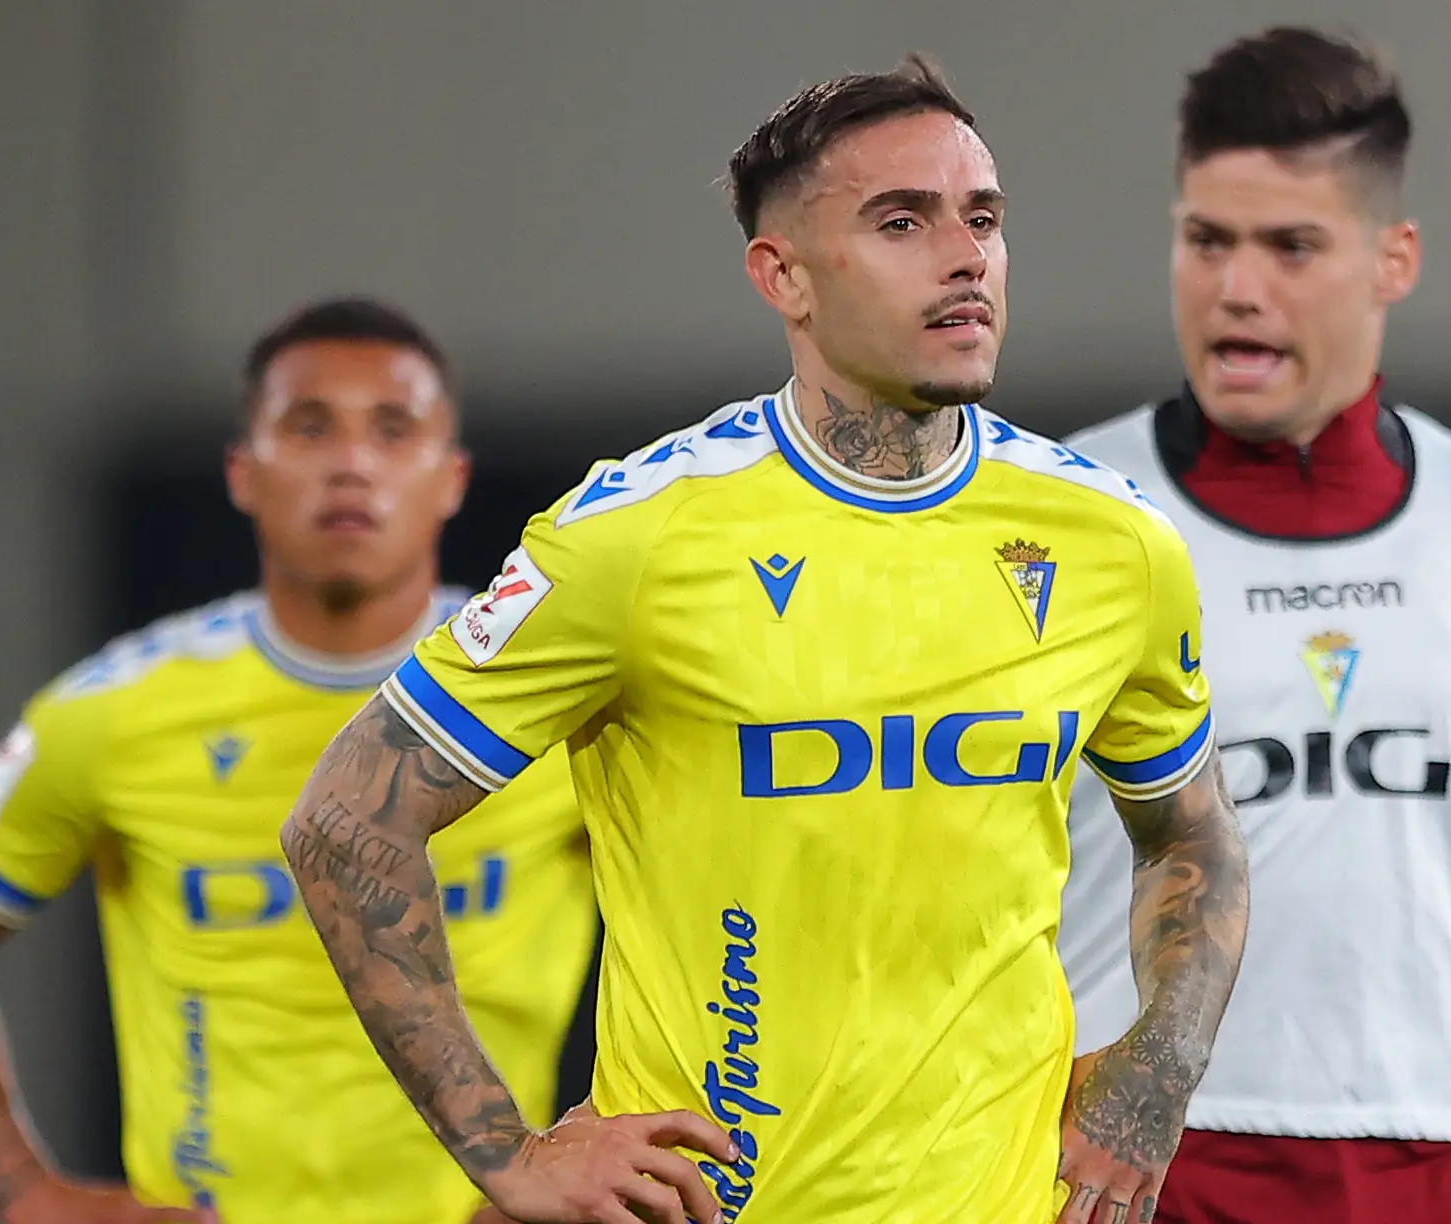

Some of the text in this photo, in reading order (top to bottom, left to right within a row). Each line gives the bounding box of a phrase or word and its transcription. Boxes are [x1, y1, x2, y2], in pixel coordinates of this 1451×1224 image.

[1246, 581, 1405, 614] macron
[739, 711, 1078, 797] DIGI
[702, 898, 781, 1125] Turismo
